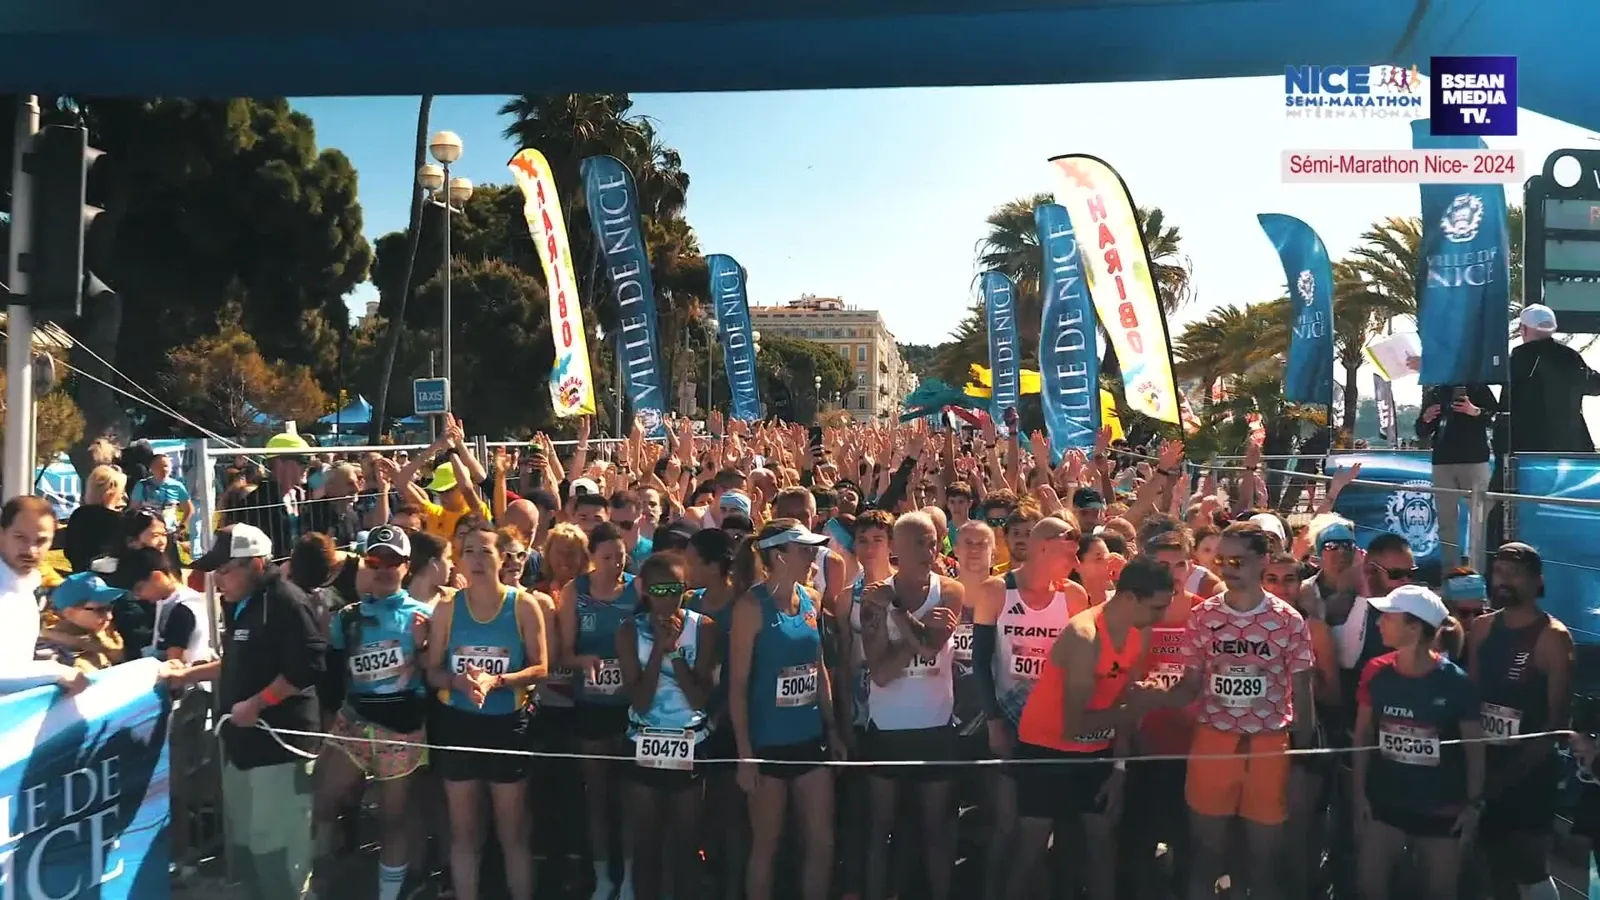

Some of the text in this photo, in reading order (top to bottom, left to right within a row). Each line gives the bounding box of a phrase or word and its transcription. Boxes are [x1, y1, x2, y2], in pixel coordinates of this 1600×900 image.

[599, 170, 660, 404] VILLE DE NICE
[1427, 262, 1494, 288] NICE
[993, 281, 1012, 330] NICE
[719, 265, 756, 406] VILLE DE NICE
[1049, 223, 1093, 440] VILLE DE NICE
[997, 336, 1014, 362] DE
[417, 390, 443, 402] TAXIS
[1003, 624, 1062, 638] FRANC
[1212, 639, 1271, 657] KENYA
[354, 649, 399, 673] 50324
[781, 675, 816, 696] 50042
[1214, 676, 1262, 696] 50289
[1383, 704, 1414, 718] ULTRA
[641, 738, 689, 758] 50479
[61, 755, 121, 820] DE
